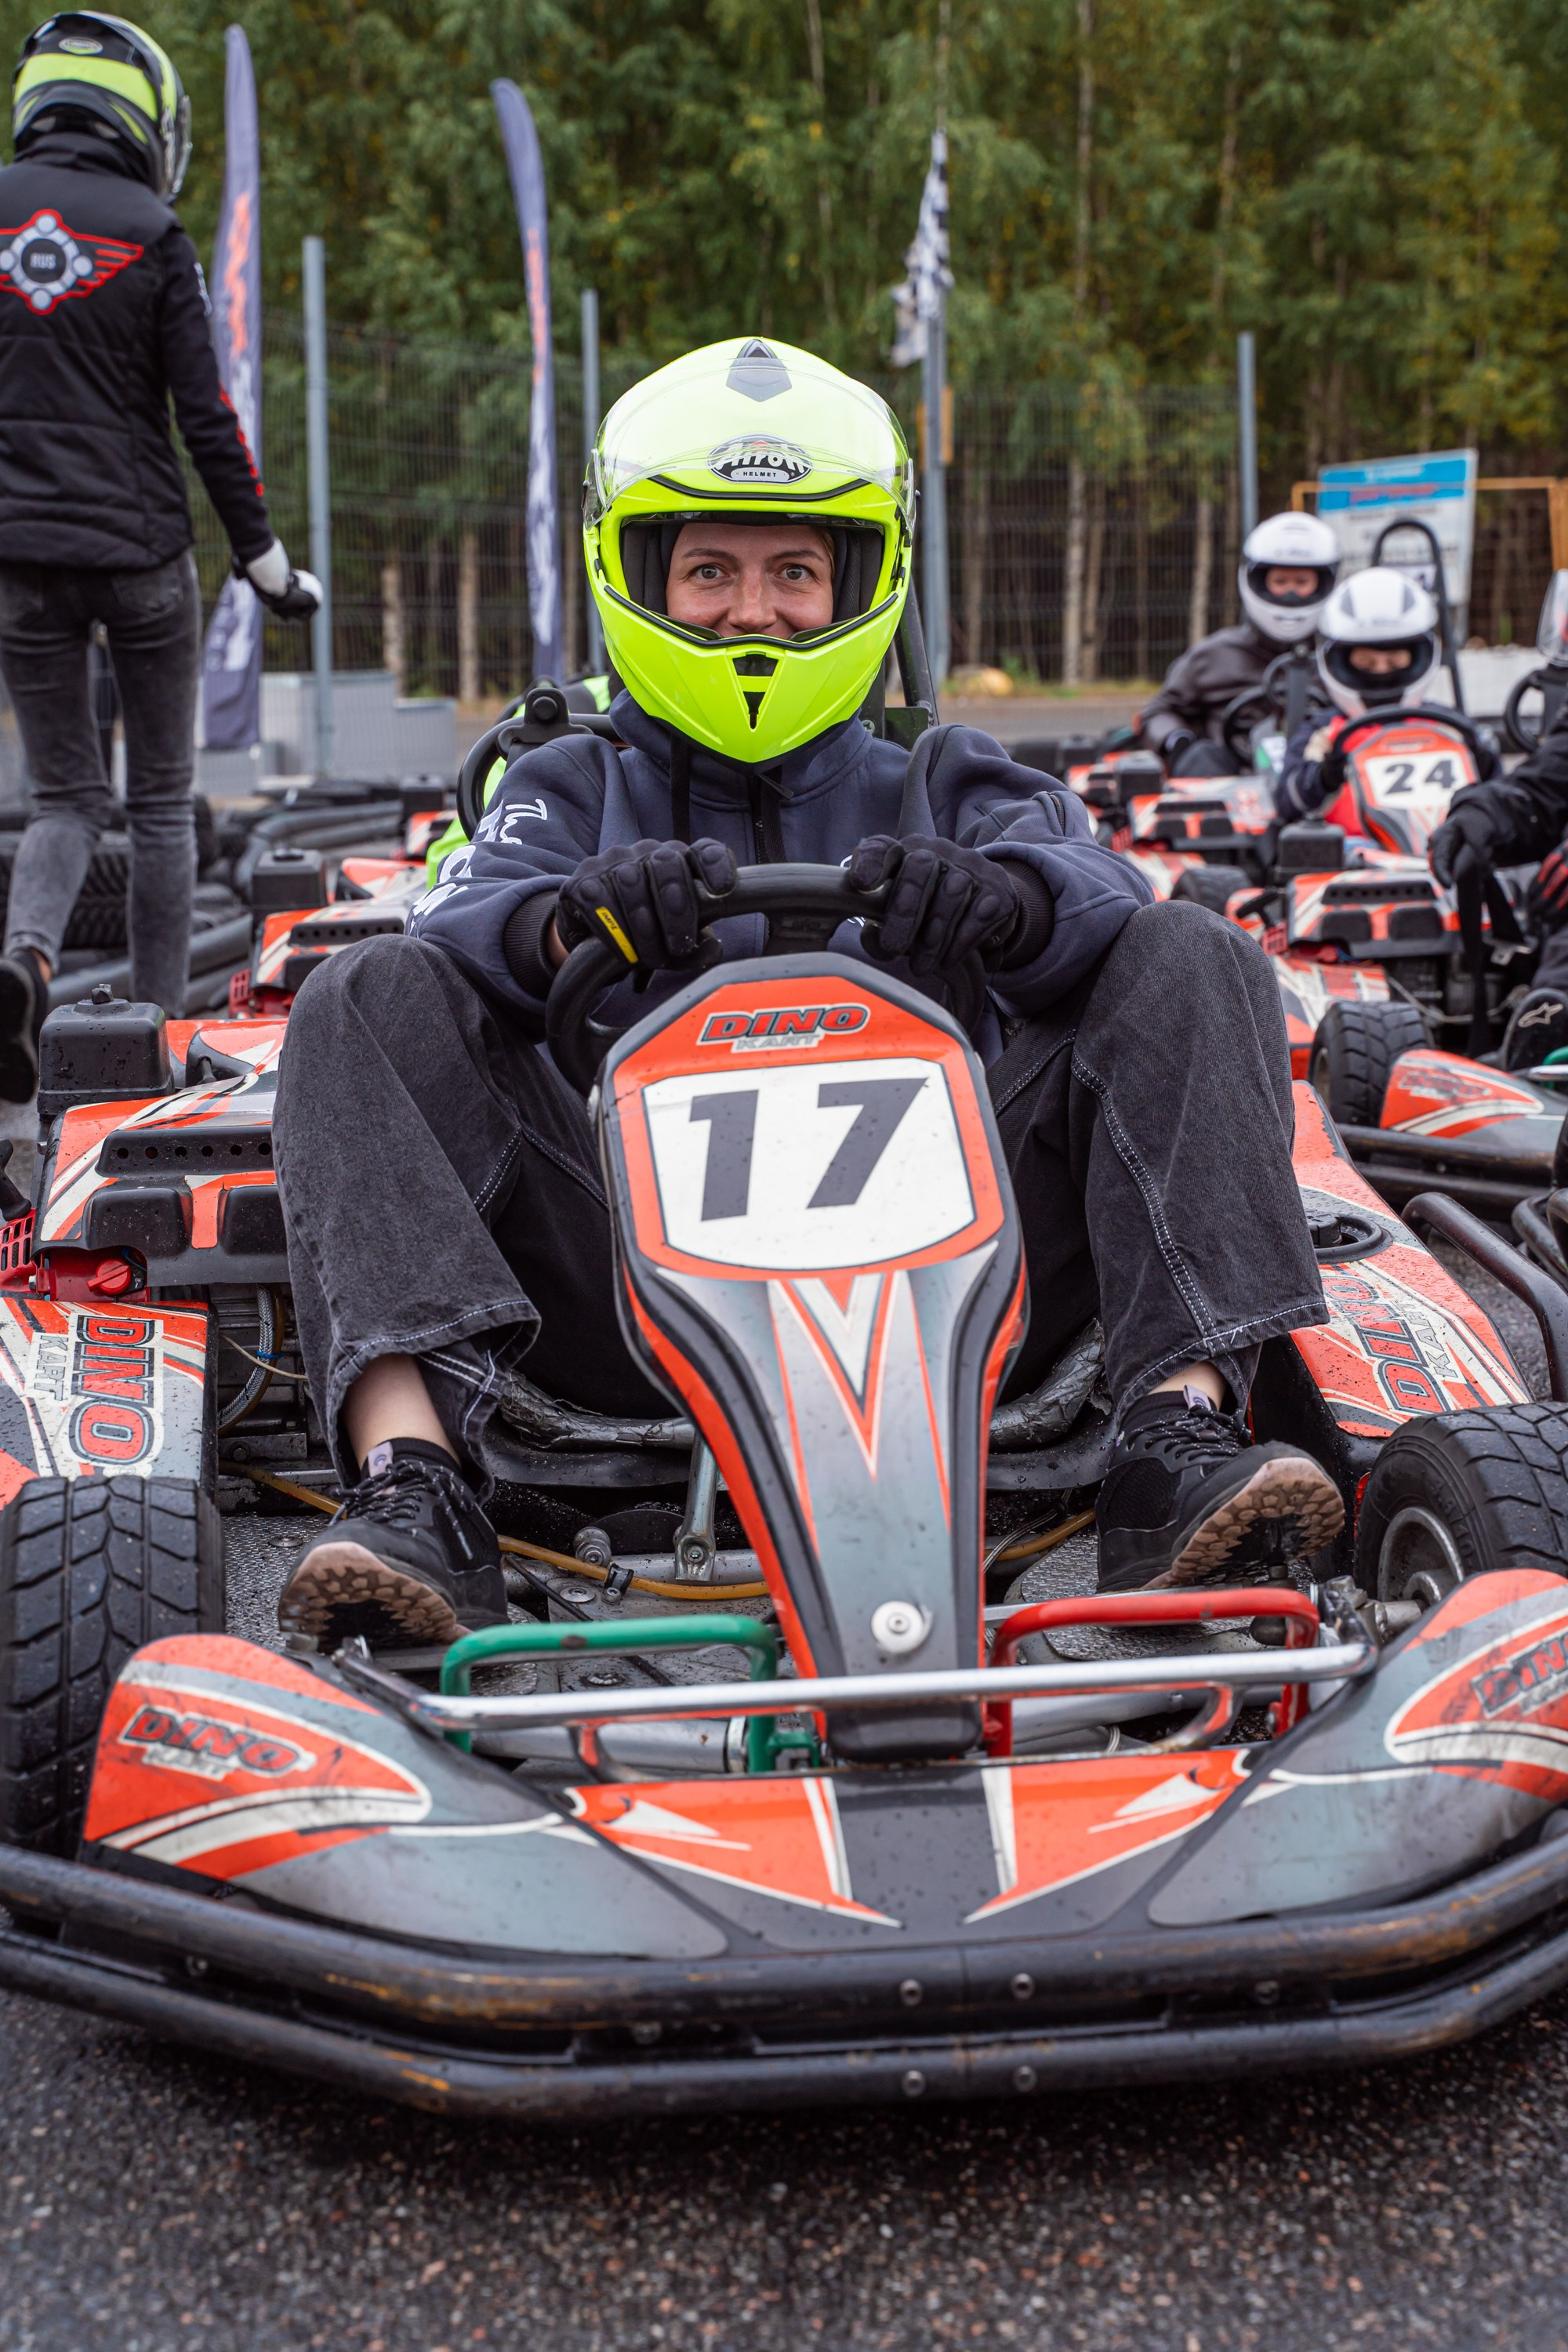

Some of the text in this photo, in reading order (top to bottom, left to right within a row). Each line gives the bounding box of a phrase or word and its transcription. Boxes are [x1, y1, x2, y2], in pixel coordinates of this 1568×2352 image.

[1385, 759, 1455, 795] 24
[701, 1007, 868, 1042] DINO
[735, 1035, 819, 1050] KART
[689, 1077, 928, 1221] 17
[34, 1335, 69, 1401] KART
[1321, 1276, 1452, 1414] DINO
[69, 1315, 155, 1465] DINO
[1472, 1632, 1568, 1713] DIN
[123, 1707, 300, 1774] DINO
